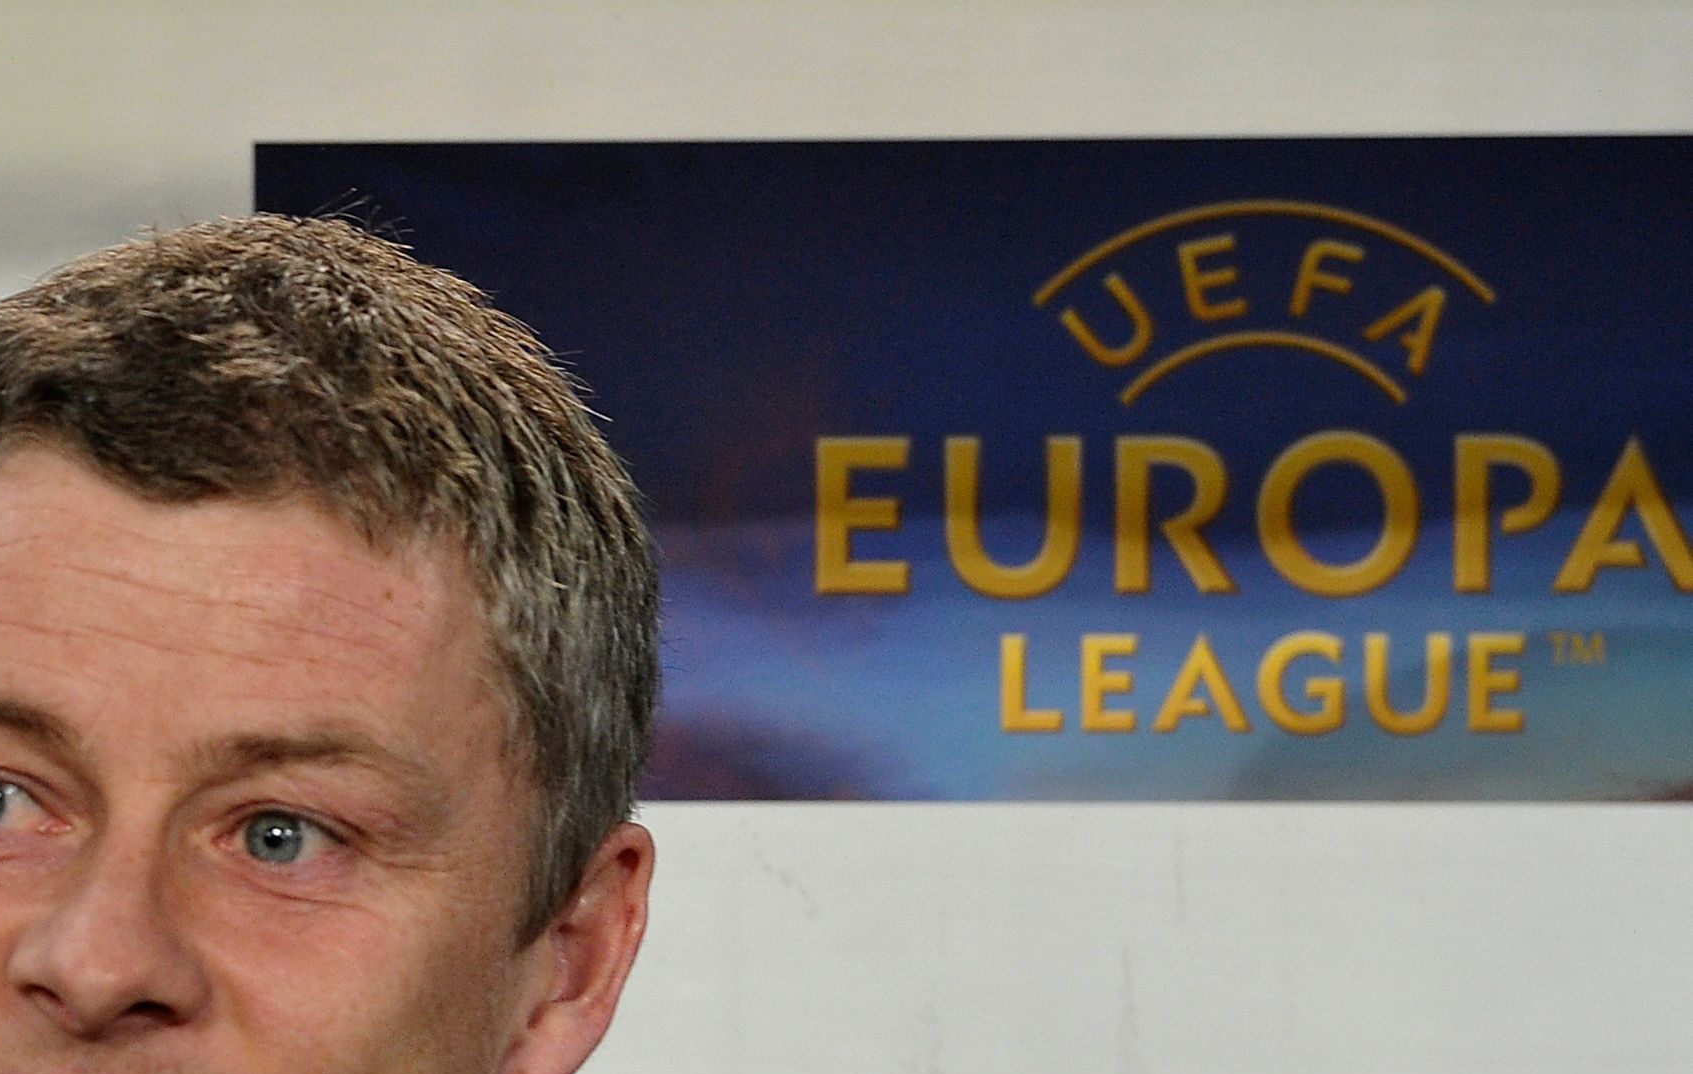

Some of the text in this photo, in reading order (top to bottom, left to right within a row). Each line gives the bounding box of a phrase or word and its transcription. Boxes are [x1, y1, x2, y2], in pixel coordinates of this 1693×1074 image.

[1062, 235, 1446, 375] UEFA
[814, 431, 1693, 598] EUROPA
[1000, 631, 1527, 736] LEAGUE
